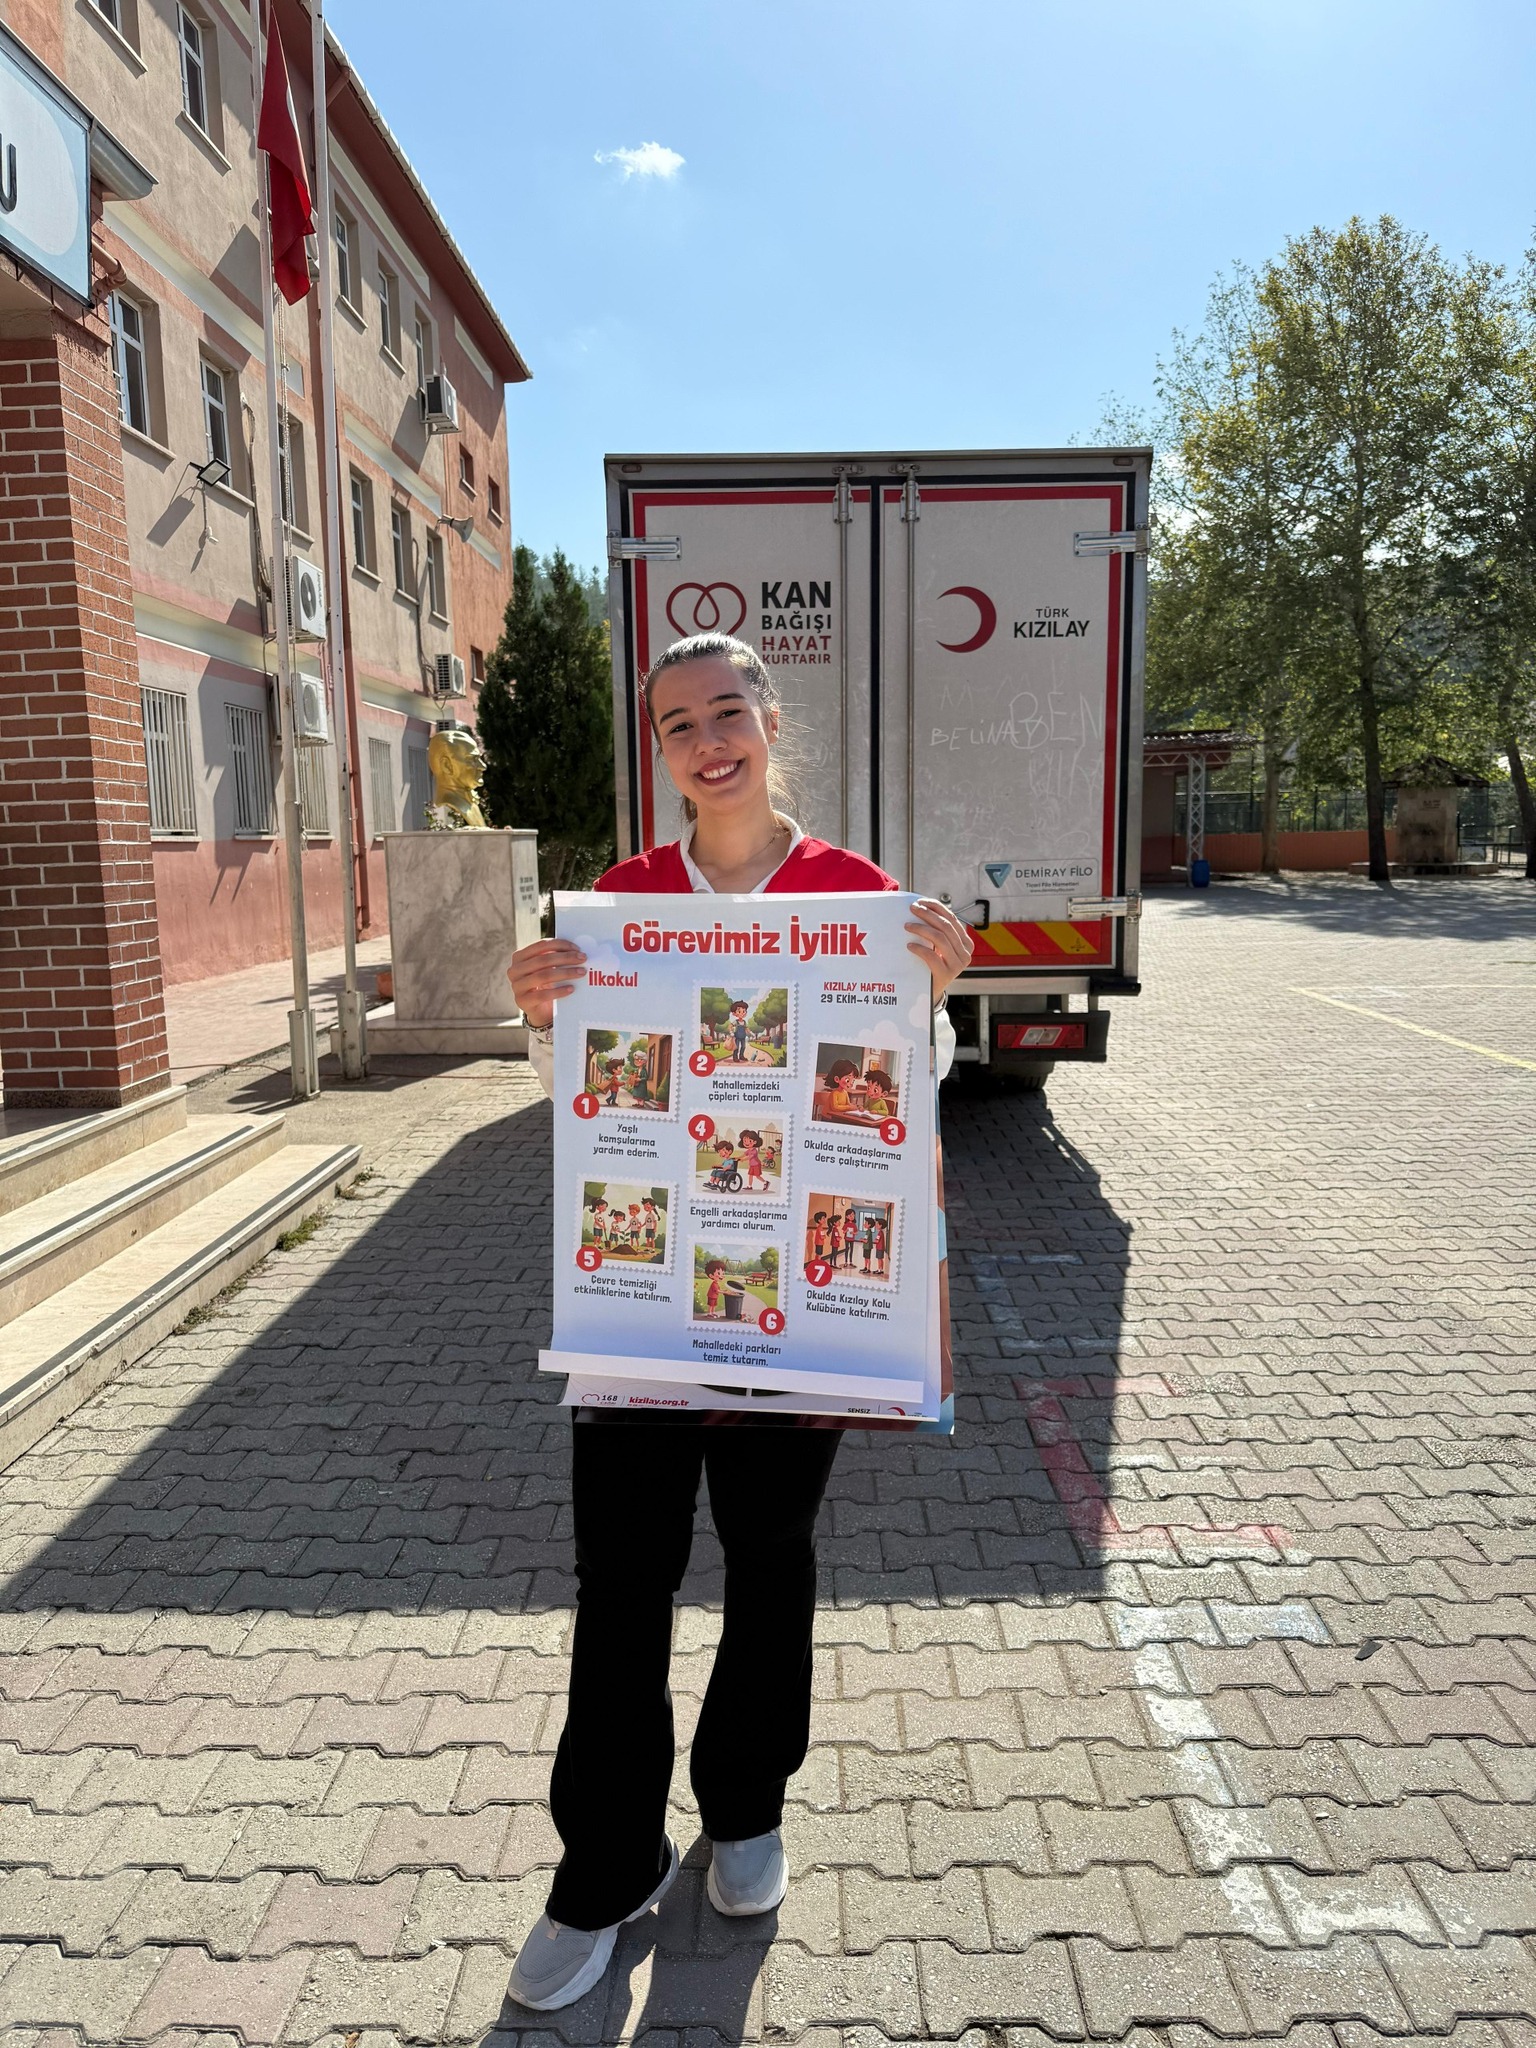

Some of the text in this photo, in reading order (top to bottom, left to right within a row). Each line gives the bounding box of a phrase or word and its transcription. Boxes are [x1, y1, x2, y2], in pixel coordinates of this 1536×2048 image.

[762, 581, 831, 609] KAN
[1036, 606, 1069, 618] TÜRK
[762, 611, 831, 633] BAĞIŞI
[1014, 620, 1090, 638] KIZILAY
[762, 635, 831, 651] HAYAT
[762, 654, 831, 664] KURTARIR
[1016, 866, 1093, 878] DEMİRAY FİLO
[623, 915, 868, 961] Görevimiz İyilik
[589, 968, 638, 987] İlkokul
[824, 981, 895, 993] KIZILAY HAFTASI
[821, 994, 833, 1003] 29
[872, 995, 897, 1005] KASIM
[696, 1055, 707, 1071] 2
[712, 1080, 780, 1090] Mahallemizdeki
[708, 1091, 784, 1103] çöpleri toplarım.
[580, 1098, 592, 1114] 1
[617, 1123, 638, 1134] Yaşlı
[695, 1121, 707, 1136] 4
[887, 1124, 899, 1139] 3
[598, 1133, 656, 1146] komşularıma
[593, 1146, 659, 1159] yardım ederim.
[804, 1140, 901, 1160] Okulda arkadaşlarıma
[815, 1152, 889, 1170] ders çalıştırırım
[690, 1206, 788, 1220] Engelli arkadaşlarıma
[701, 1219, 776, 1231] yardımcı olurum.
[583, 1251, 595, 1267] 5
[814, 1266, 826, 1282] 7
[591, 1275, 657, 1291] Çevre temizliği
[574, 1285, 672, 1303] etkinliklerine katılırım.
[807, 1290, 891, 1308] Okulda Kızılay Kolu
[806, 1301, 889, 1320] Kulübüne katılırım.
[766, 1313, 777, 1329] 6
[693, 1339, 781, 1355] Mahalledeki parkları
[703, 1352, 768, 1366] temiz tutarım.
[629, 1396, 689, 1406] kizilay.org.tr
